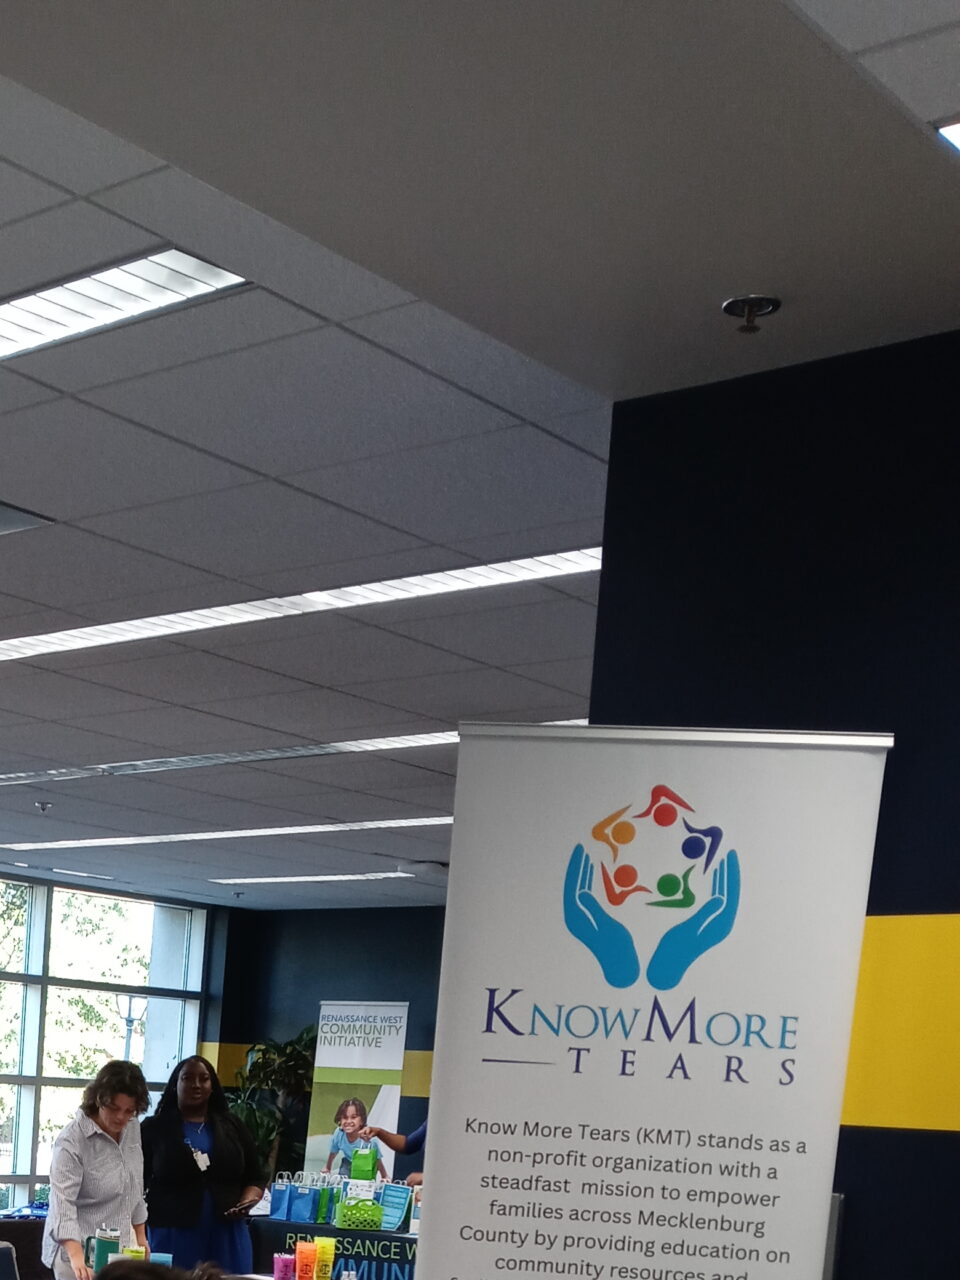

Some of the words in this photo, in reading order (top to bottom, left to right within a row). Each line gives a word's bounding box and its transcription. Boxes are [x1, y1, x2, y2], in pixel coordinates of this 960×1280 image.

[320, 1023, 402, 1036] COMMUNITY
[321, 1015, 378, 1024] RENAISSANCE
[380, 1016, 403, 1024] WEST
[320, 1035, 382, 1048] INITIATIVE
[567, 1046, 797, 1087] TEARS
[465, 1117, 518, 1136] Know
[522, 1120, 573, 1139] More
[578, 1123, 631, 1143] Tears
[636, 1127, 692, 1149] (KMT)
[696, 1133, 764, 1151] stands
[769, 1139, 791, 1153] as
[795, 1141, 807, 1154] a
[487, 1149, 588, 1169] non-profit
[591, 1155, 713, 1176] organization
[718, 1160, 761, 1179] with
[766, 1167, 778, 1180] a
[480, 1174, 572, 1194] steadfast
[581, 1179, 655, 1199] mission
[660, 1184, 681, 1201] to
[686, 1189, 781, 1208] empower
[489, 1199, 564, 1220] families
[568, 1208, 632, 1225] across
[637, 1209, 766, 1239] Mecklenburg
[286, 1233, 401, 1259] RENSSANCE
[459, 1225, 530, 1249] County
[534, 1228, 559, 1251] by
[562, 1234, 656, 1258] providing
[660, 1239, 760, 1262] education
[765, 1250, 791, 1264] on
[494, 1257, 605, 1280] community
